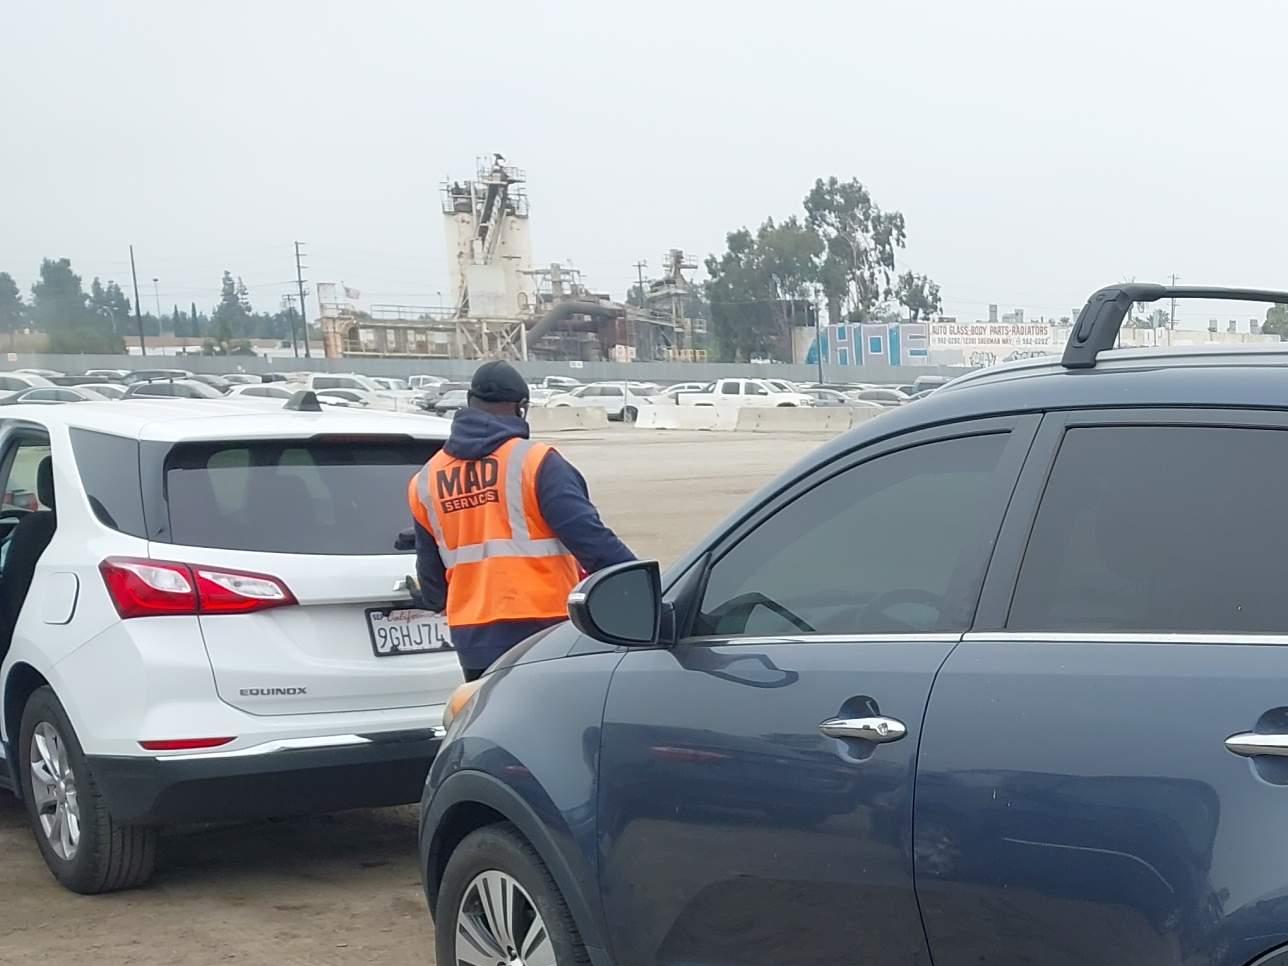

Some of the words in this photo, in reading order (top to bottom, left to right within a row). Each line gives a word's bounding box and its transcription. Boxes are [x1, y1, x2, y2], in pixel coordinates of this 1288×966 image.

[932, 325, 947, 335] AUTO
[437, 456, 499, 500] MAD
[444, 490, 496, 512] SERVICS
[378, 622, 449, 649] 9GHJ74
[239, 687, 307, 696] EQUINOX
